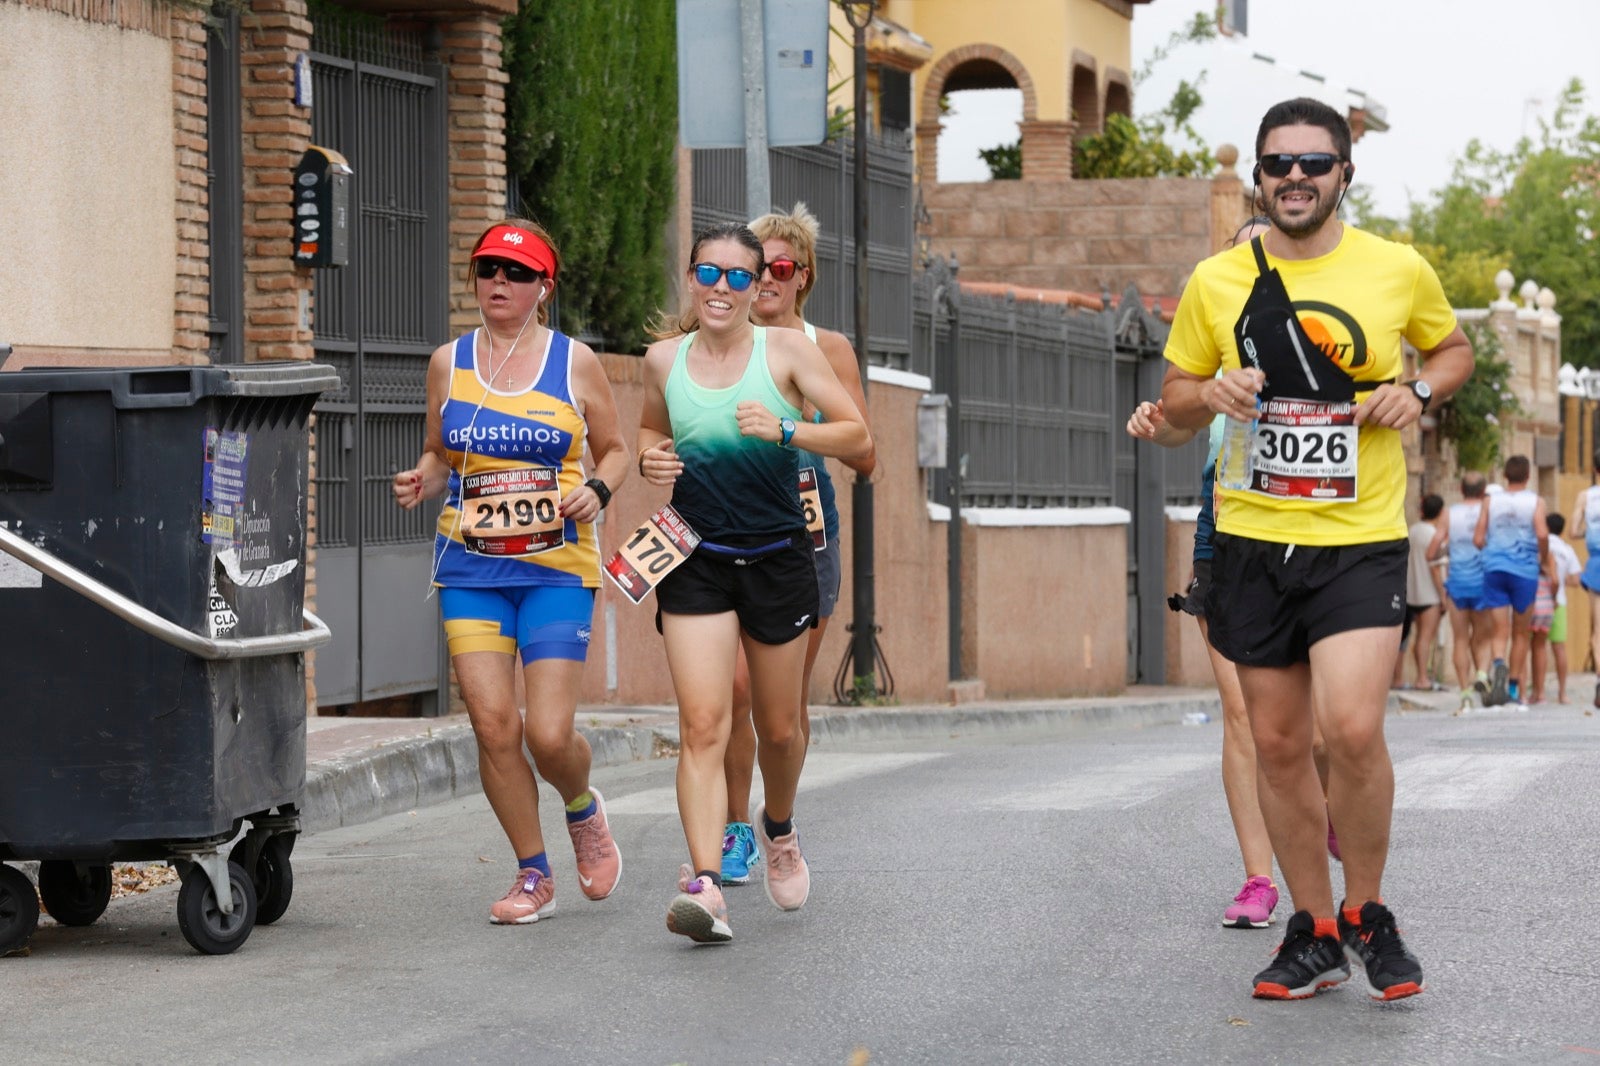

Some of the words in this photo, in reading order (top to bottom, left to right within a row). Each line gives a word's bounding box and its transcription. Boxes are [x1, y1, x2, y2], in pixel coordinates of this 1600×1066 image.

[1268, 401, 1289, 415] GRAN
[1289, 402, 1316, 416] PREMIO
[1317, 403, 1326, 416] DE
[449, 423, 561, 447] agustinos
[1259, 428, 1348, 464] 3026
[480, 473, 497, 487] GRAN
[497, 470, 521, 485] PREMIO
[522, 470, 530, 482] DE
[531, 469, 551, 481] FONDO
[475, 497, 555, 529] 2190
[801, 498, 817, 525] 6
[243, 512, 271, 539] Diputación
[243, 541, 249, 561] de
[249, 539, 270, 561] Granada
[627, 527, 675, 575] 170
